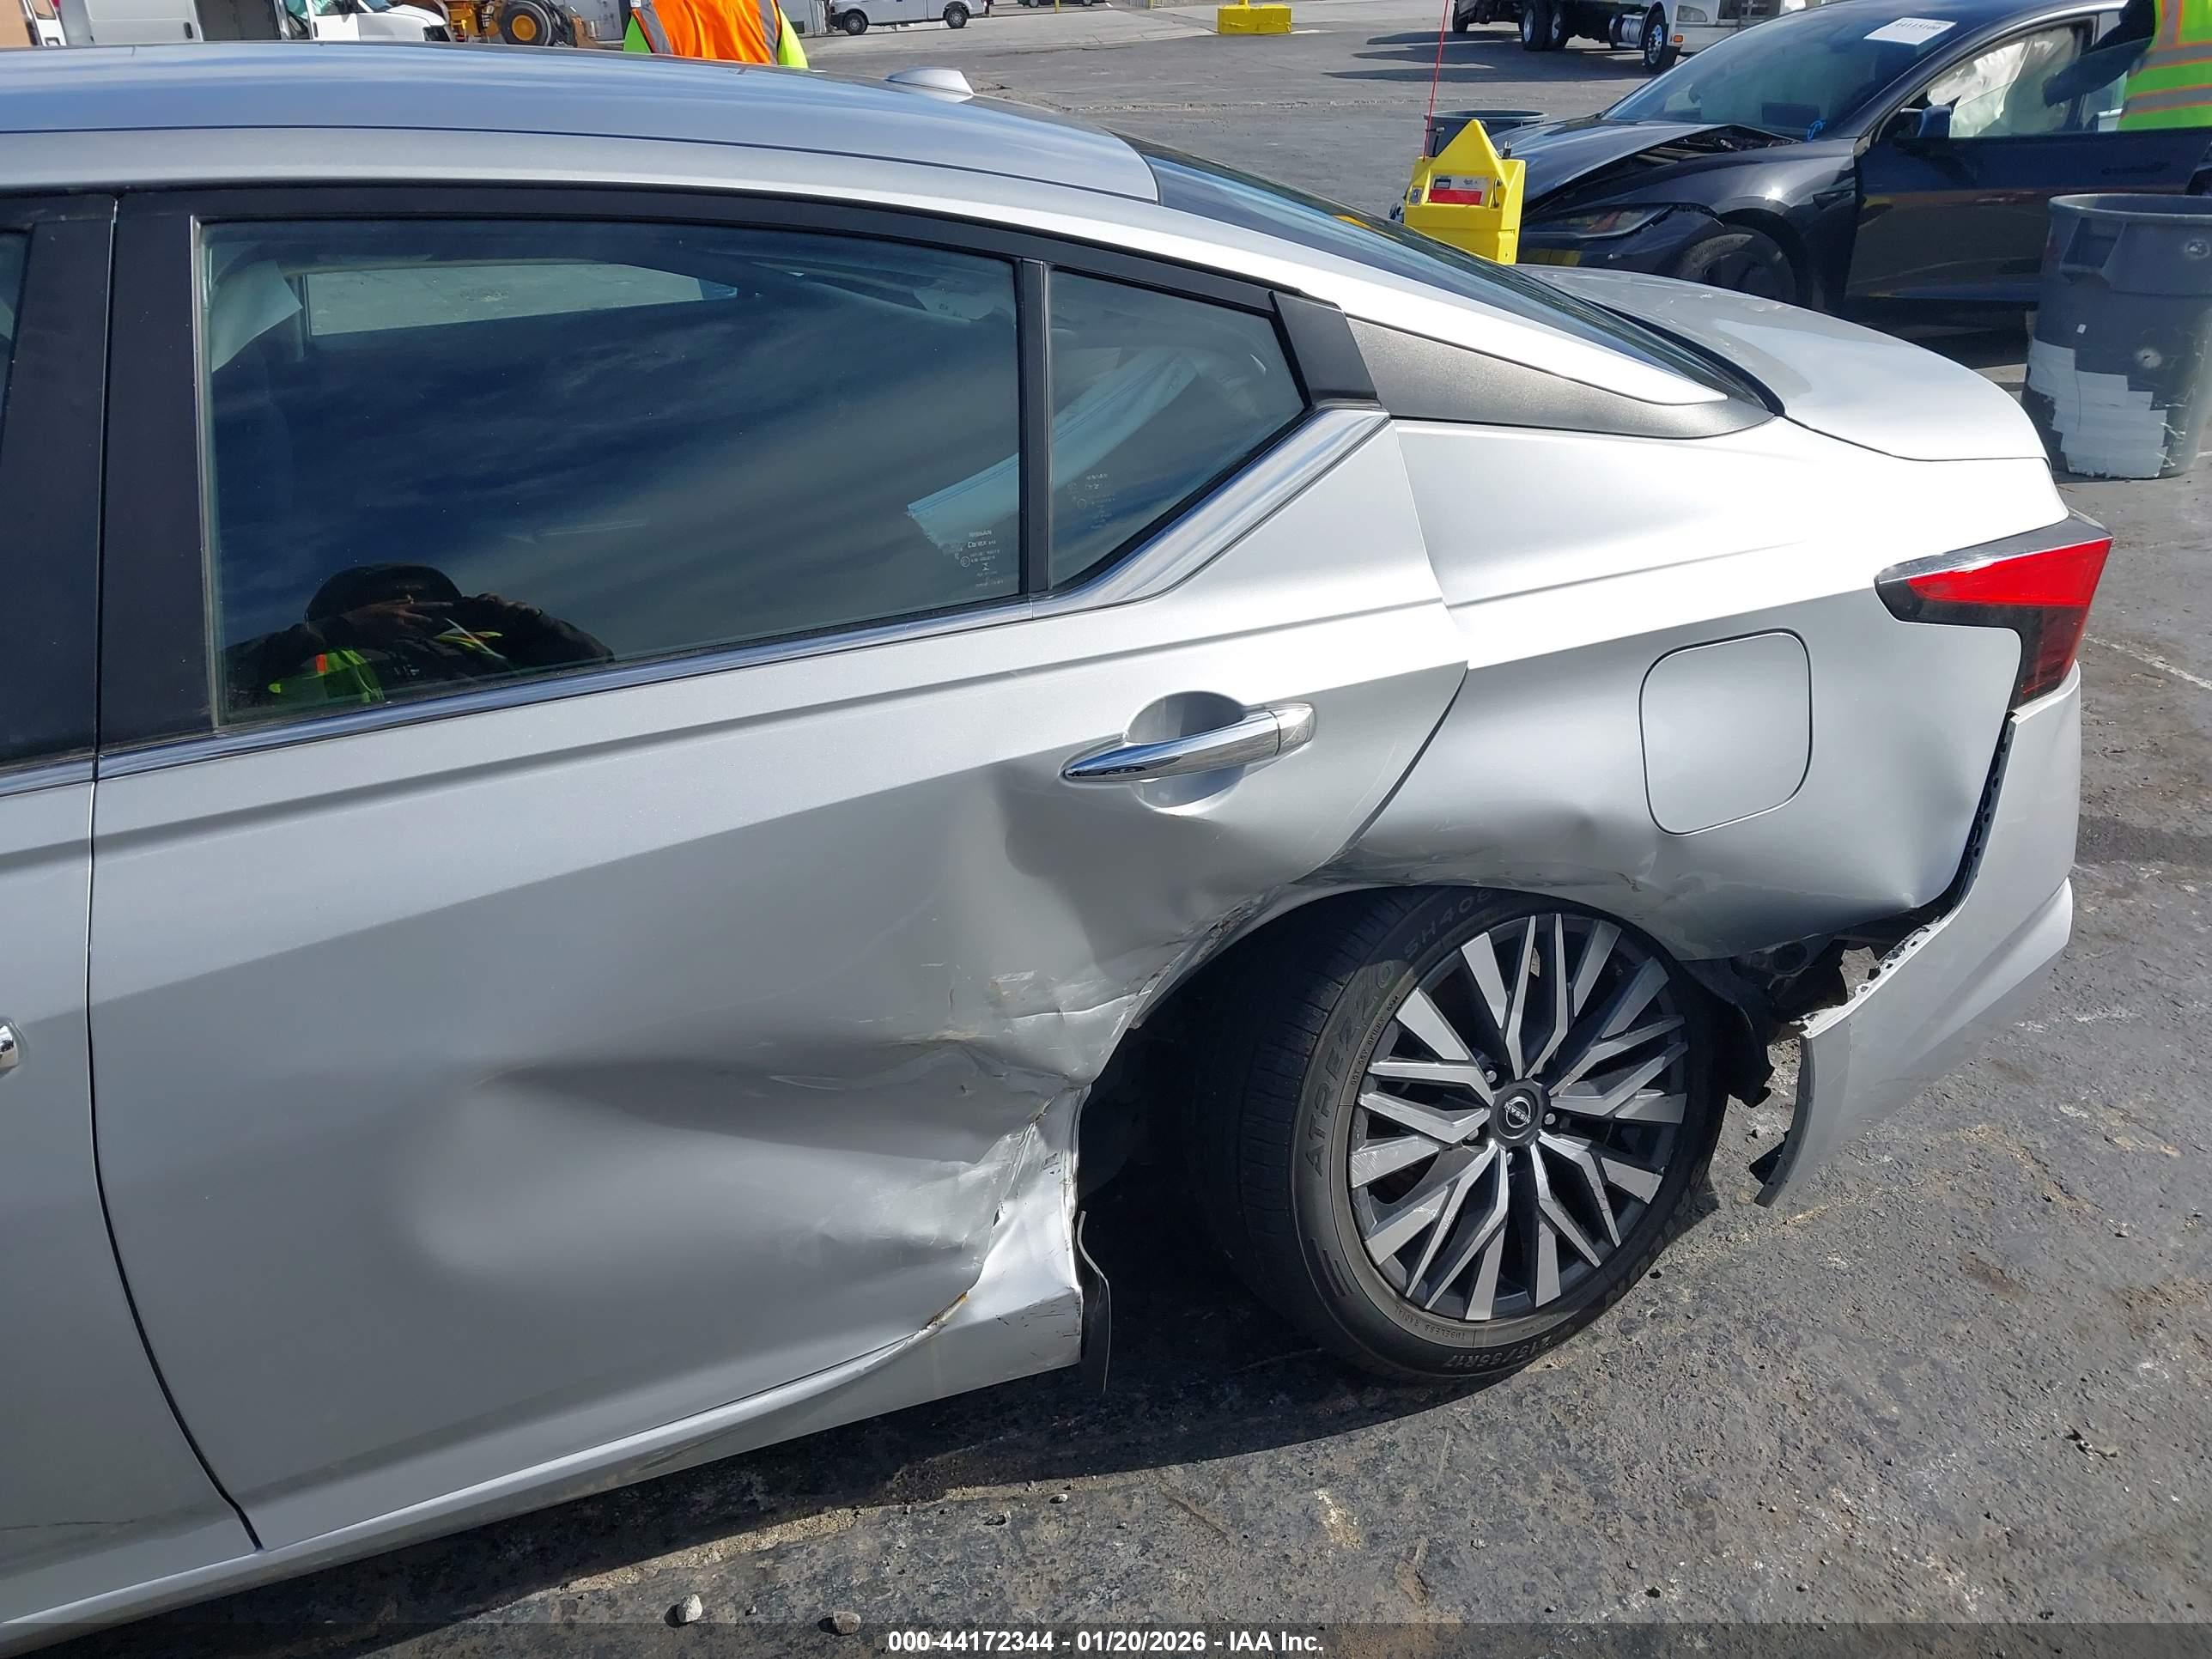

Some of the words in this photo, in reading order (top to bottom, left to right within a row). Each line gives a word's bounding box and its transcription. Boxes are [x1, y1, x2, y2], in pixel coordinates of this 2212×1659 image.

[1504, 1102, 1531, 1124] NISSAN
[1425, 1324, 1466, 1340] TUBELESS
[1443, 1334, 1553, 1368] 215/55R17
